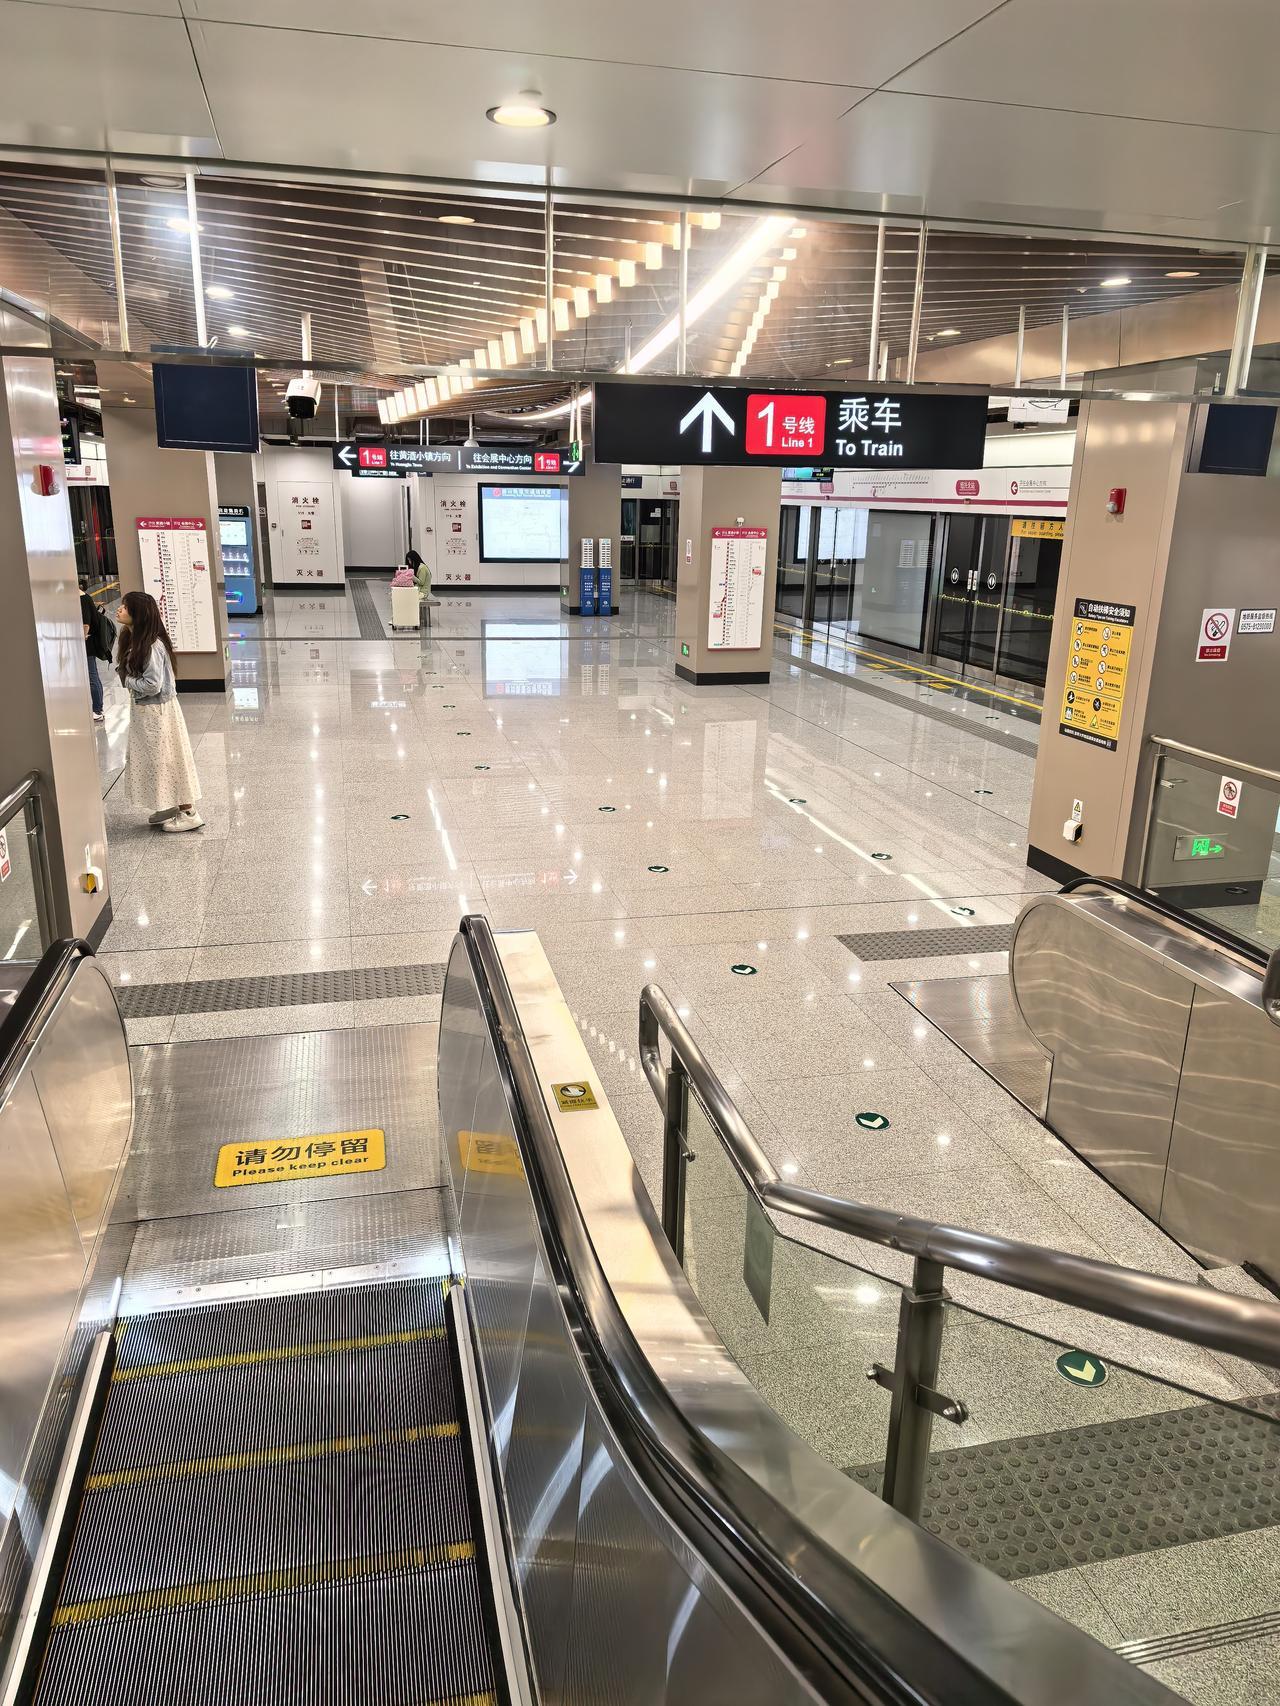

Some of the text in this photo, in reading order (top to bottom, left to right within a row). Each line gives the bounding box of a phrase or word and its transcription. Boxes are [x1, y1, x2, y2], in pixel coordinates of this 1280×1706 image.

[838, 397, 902, 433] 乘车
[758, 401, 815, 447] 1 号线
[782, 437, 814, 448] Line 1
[836, 439, 904, 456] To Train
[363, 449, 369, 465] 1
[390, 449, 452, 462] 往黄酒小镇方向
[473, 453, 533, 464] 往会展中心方向
[538, 455, 544, 469] 1
[235, 1137, 368, 1166] 请勿停留
[232, 1157, 369, 1177] Please keep clear
